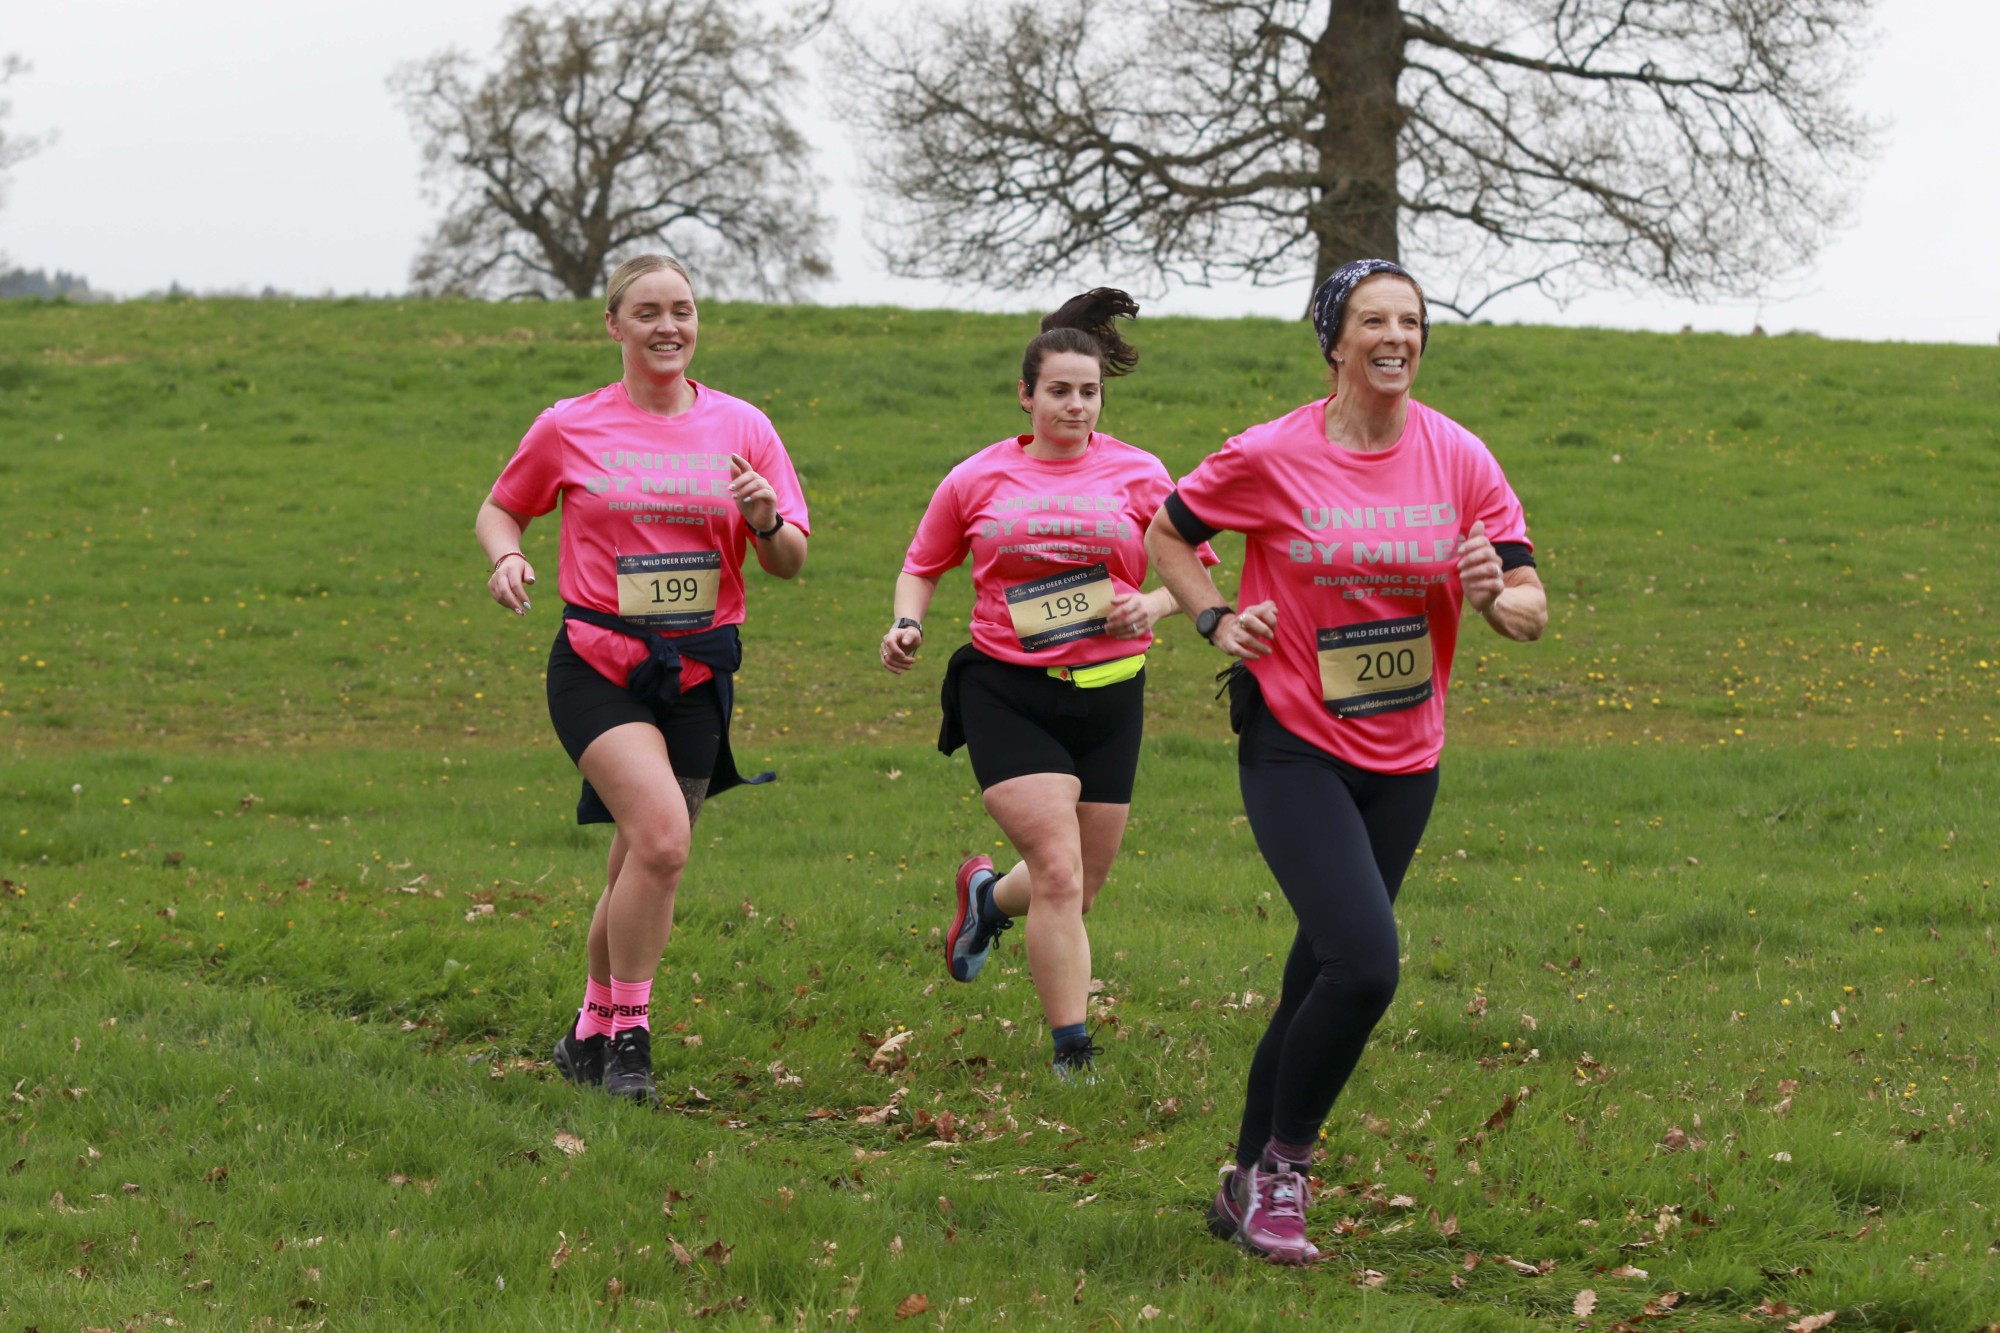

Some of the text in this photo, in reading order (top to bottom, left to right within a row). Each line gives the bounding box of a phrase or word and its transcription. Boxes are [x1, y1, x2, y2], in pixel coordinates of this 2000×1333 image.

[601, 451, 731, 471] UNITED
[585, 476, 730, 498] BY MILE
[608, 501, 726, 516] RUNNING CLUB
[994, 495, 1118, 513] UNITED
[666, 515, 704, 526] 2023
[1301, 503, 1457, 530] UNITED
[981, 518, 1132, 540] BY MILES
[998, 543, 1112, 555] RUNNING CLUB
[1289, 539, 1343, 564] BY
[641, 559, 660, 567] WILD
[680, 556, 704, 564] EVENTS
[650, 577, 698, 603] 199
[1028, 585, 1045, 594] WILD
[1046, 579, 1063, 589] DEER
[1063, 572, 1088, 584] EVENTS
[1314, 574, 1403, 586] RUNNING
[1380, 587, 1427, 598] 2023
[1041, 592, 1089, 621] 198
[1033, 625, 1105, 646] www.wilddeerevents.co.u
[1345, 630, 1367, 639] WILD
[1368, 627, 1389, 637] DEER
[1391, 623, 1421, 634] EVENTS
[1356, 648, 1415, 682] 200
